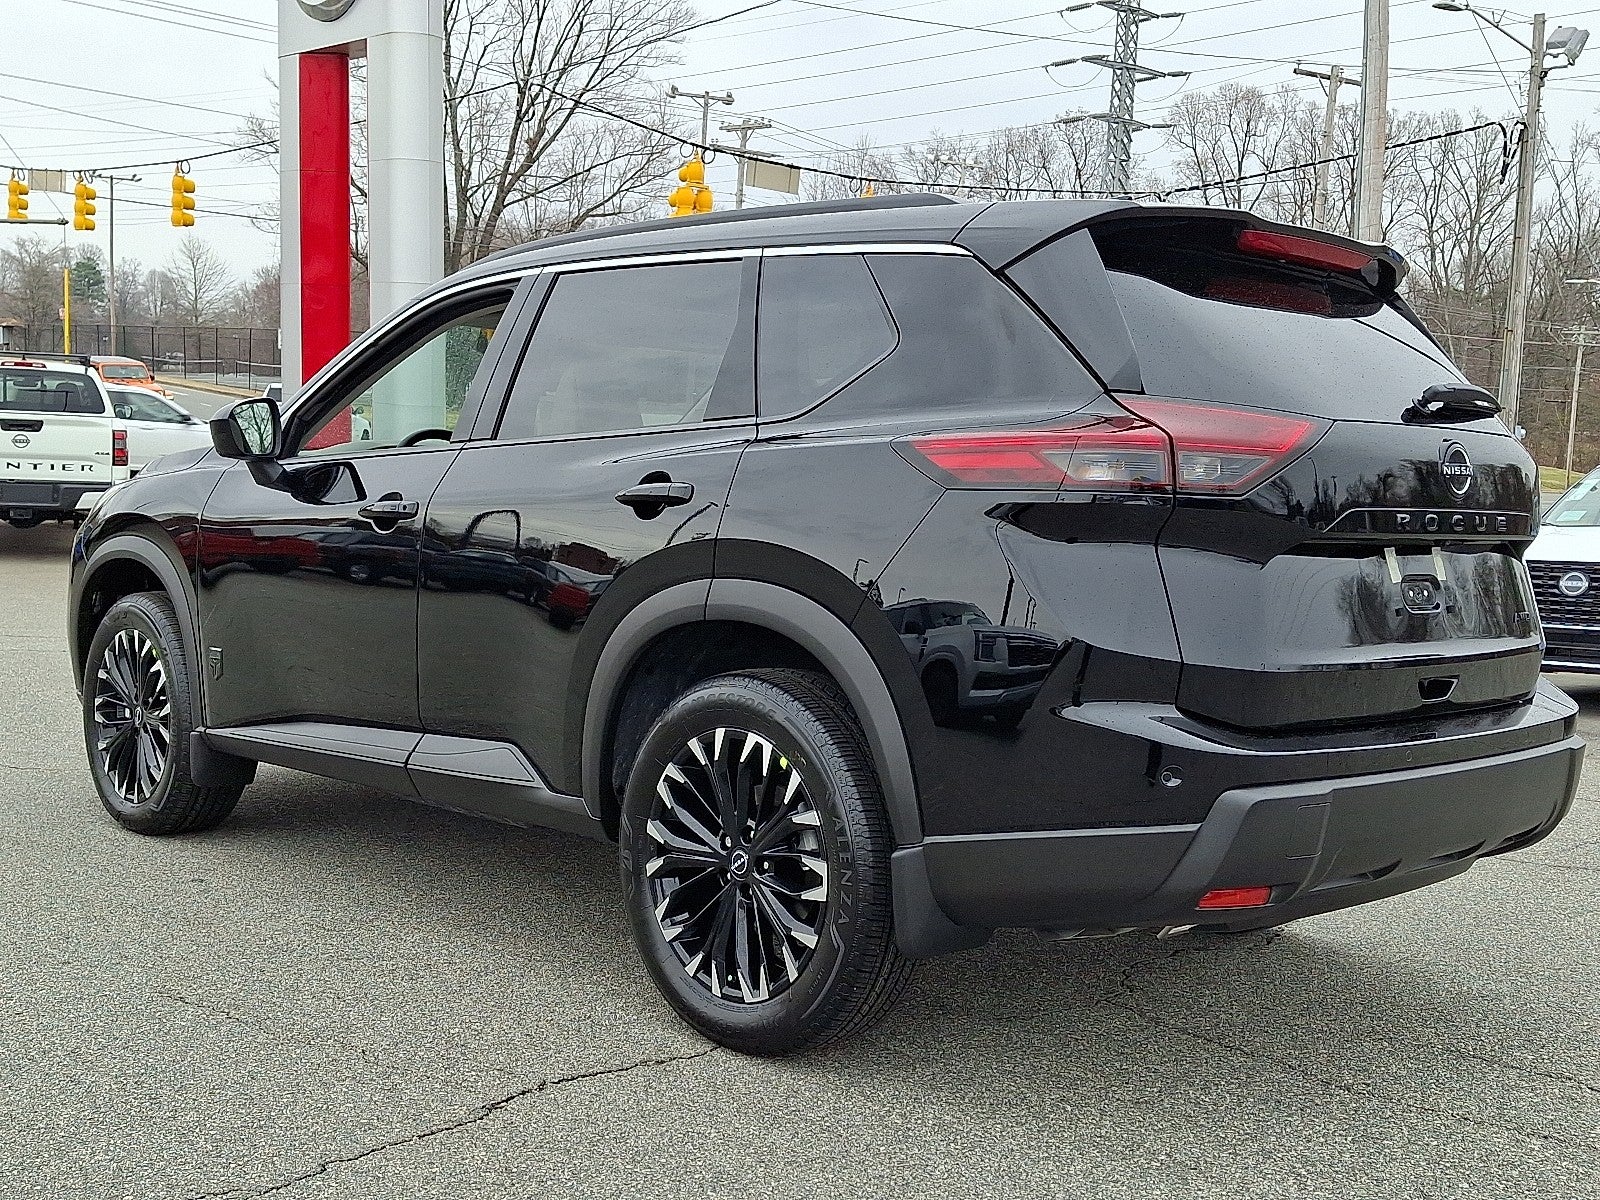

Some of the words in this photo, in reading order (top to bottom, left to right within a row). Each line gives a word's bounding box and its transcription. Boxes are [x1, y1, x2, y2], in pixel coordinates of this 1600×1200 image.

[1443, 465, 1474, 476] NISSA
[1396, 513, 1508, 532] ROGUE
[832, 816, 853, 924] ALENZA
